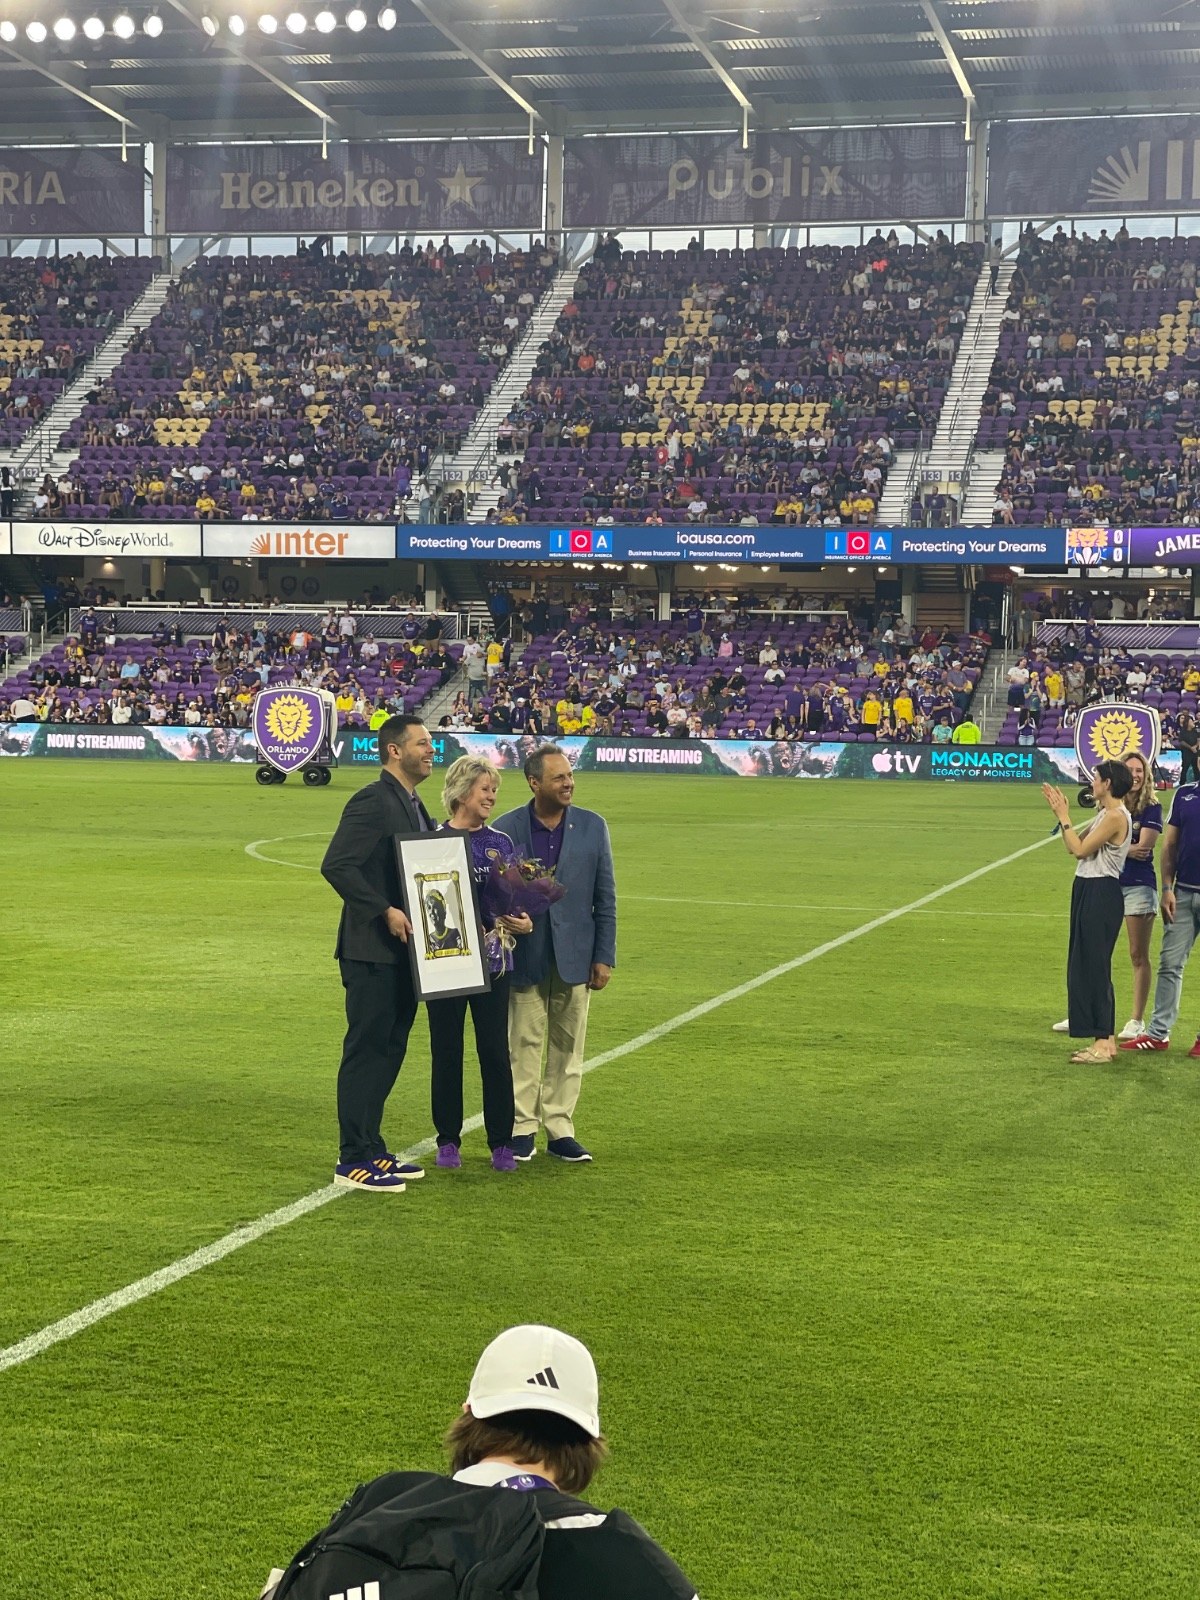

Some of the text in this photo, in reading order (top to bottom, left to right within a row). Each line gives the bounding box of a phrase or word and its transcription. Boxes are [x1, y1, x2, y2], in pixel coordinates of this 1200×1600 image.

[667, 155, 843, 201] Publix
[220, 171, 422, 209] Heineken
[444, 471, 462, 481] 132
[922, 471, 941, 481] 133
[129, 533, 169, 547] World
[410, 537, 542, 550] Protecting Your Dreams
[676, 531, 755, 545] ioausa.com
[1113, 530, 1124, 544] 0
[902, 540, 1047, 555] Protecting Your Dreams
[1113, 547, 1123, 562] 0
[751, 551, 779, 559] Employee
[47, 734, 146, 750] NOW STREAMING
[267, 745, 309, 754] ORLANDO
[596, 747, 703, 765] NOW STREAMING
[278, 753, 297, 761] CITY
[893, 750, 921, 773] tv
[931, 751, 1033, 769] MONARCH
[931, 768, 1032, 778] LEGACY OF MONSTERS
